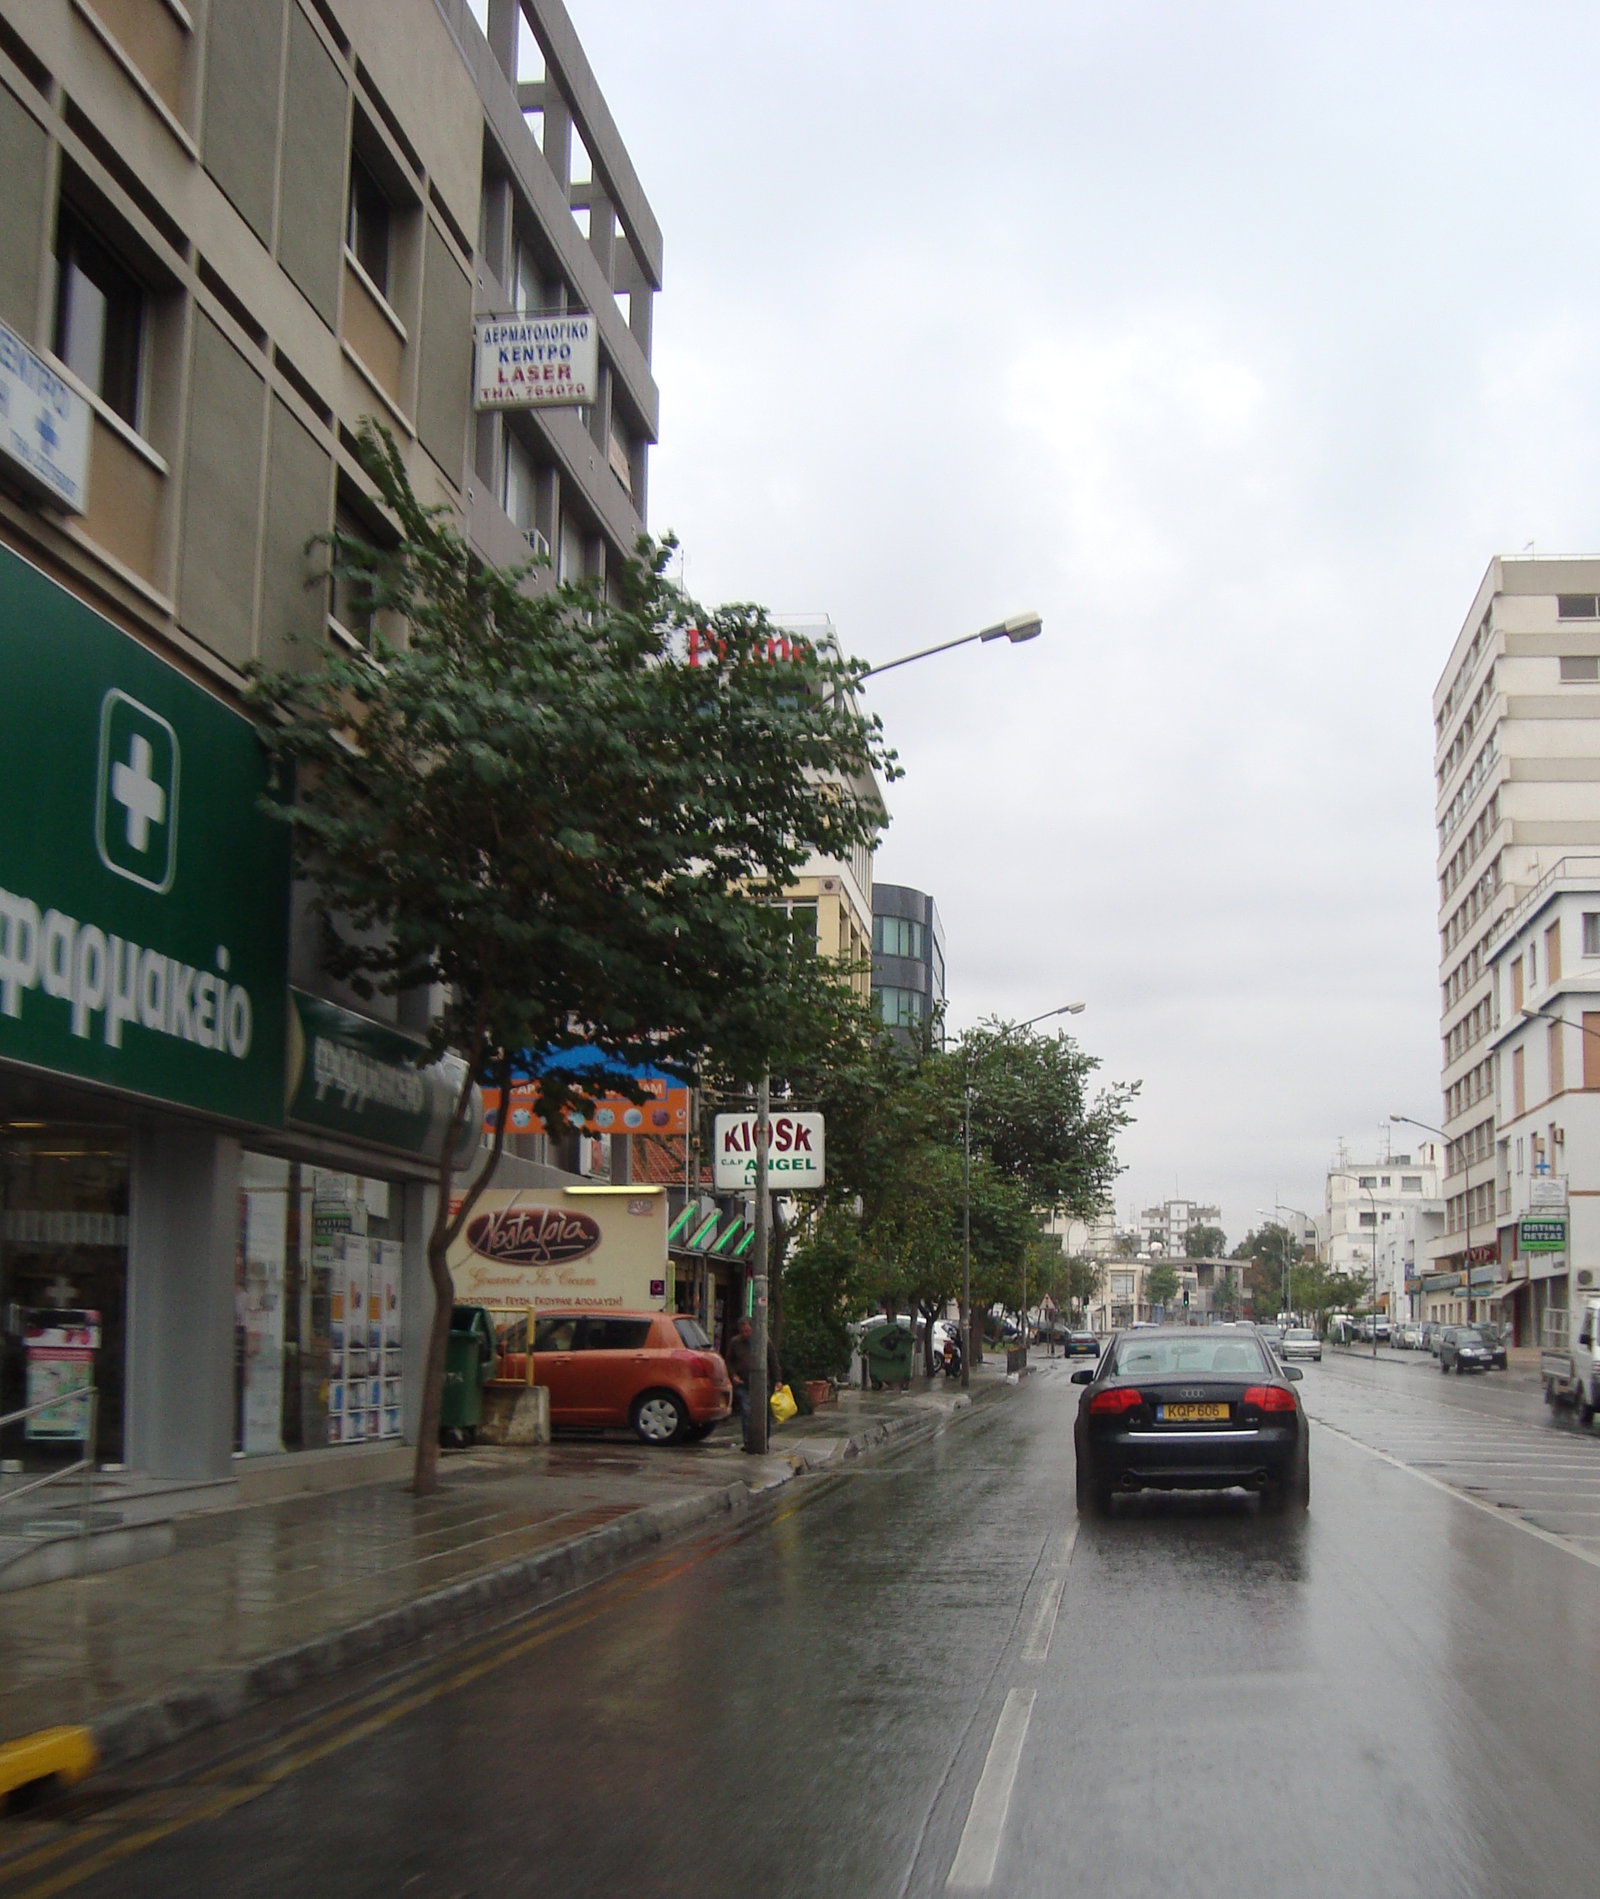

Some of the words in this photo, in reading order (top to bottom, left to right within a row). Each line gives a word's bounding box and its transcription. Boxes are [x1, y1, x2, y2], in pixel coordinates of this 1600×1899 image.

[499, 343, 571, 363] ΚΕΝΤΡΟ
[498, 363, 571, 384] LASER
[724, 1118, 812, 1152] KIOSK
[745, 1158, 817, 1171] ANGEL
[1523, 1223, 1563, 1232] ΟΠΤΙΚΑ
[1168, 1404, 1195, 1417] KQP
[1197, 1404, 1220, 1417] 606
